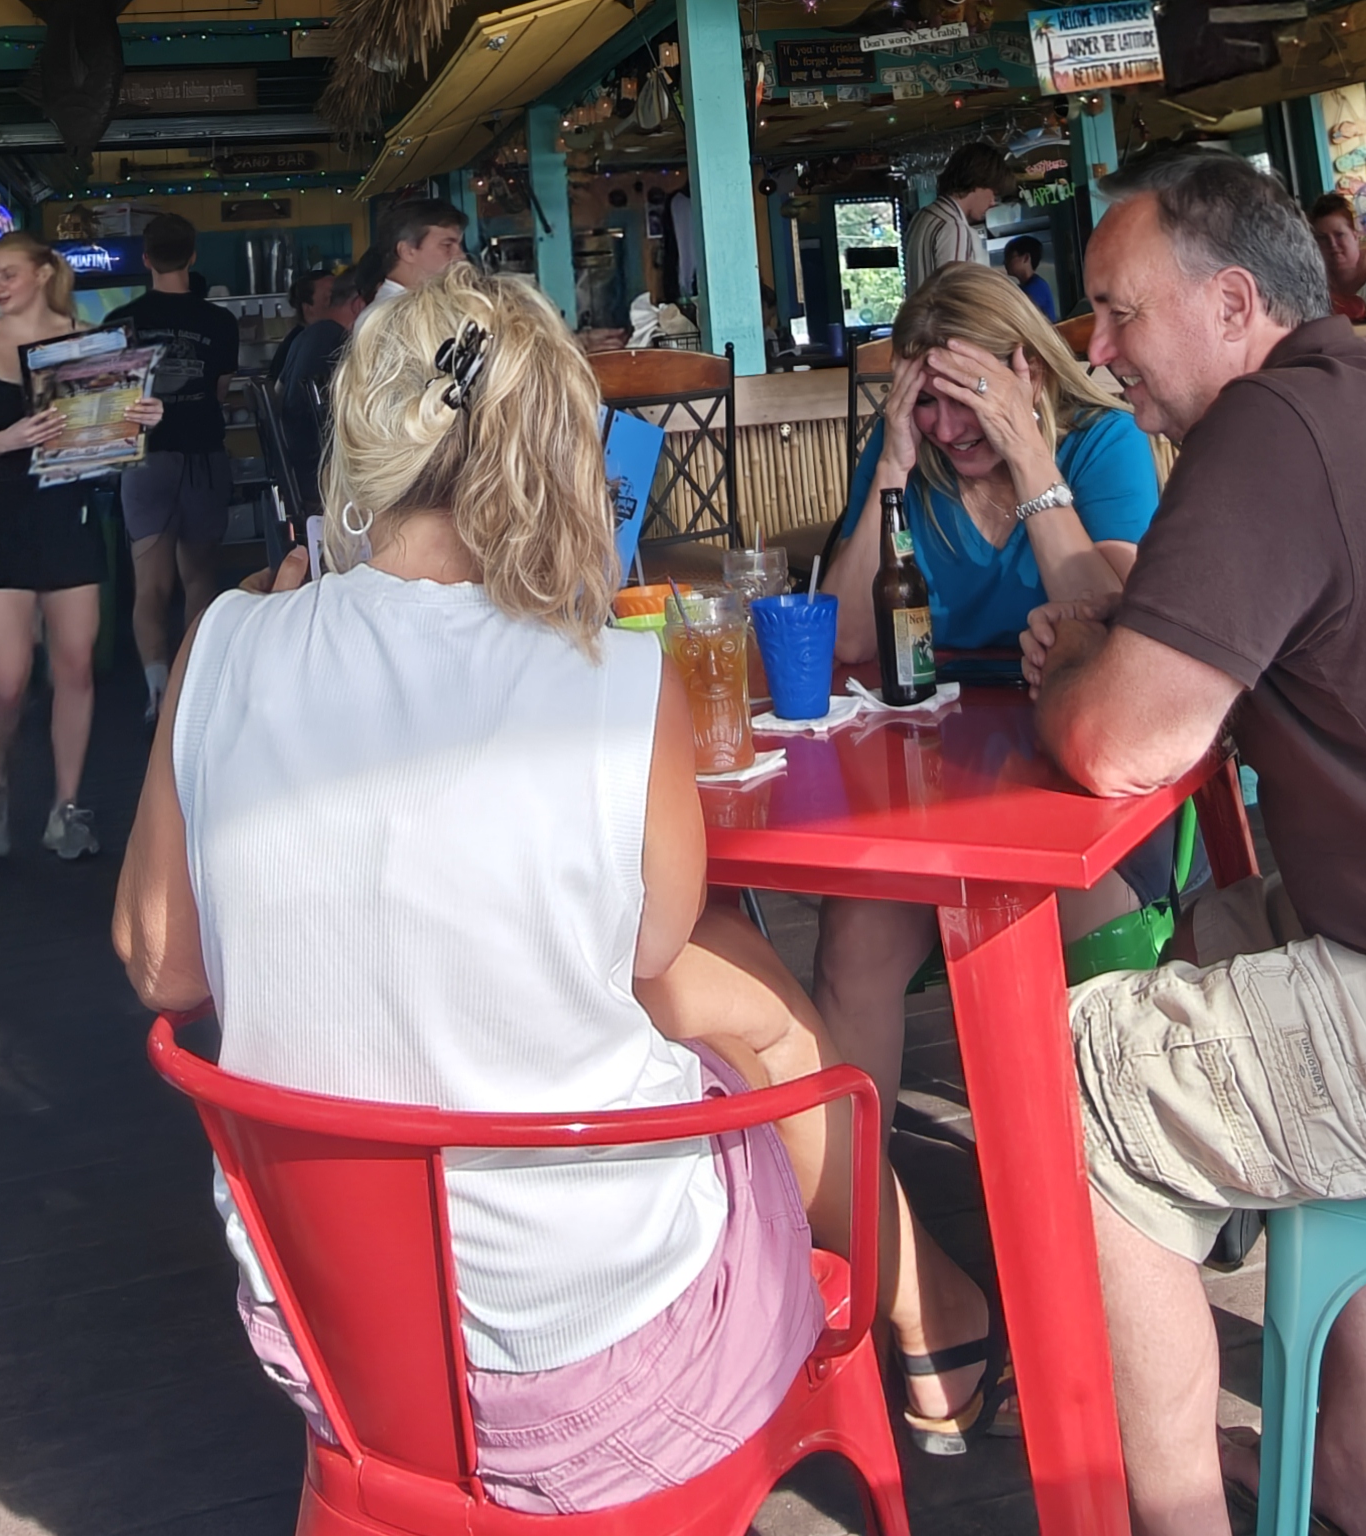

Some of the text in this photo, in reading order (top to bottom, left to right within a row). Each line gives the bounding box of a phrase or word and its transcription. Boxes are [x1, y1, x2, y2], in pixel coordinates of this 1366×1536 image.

[1057, 2, 1149, 31] WELCOME TO PARADISE
[863, 26, 962, 49] Don't worry, be Crabby
[1066, 30, 1155, 58] WARMER THE LATITUDE
[788, 54, 865, 68] to forget, please
[795, 45, 826, 57] you're
[1073, 57, 1160, 87] BETTER THE ATTITUDE
[155, 80, 174, 100] with
[182, 79, 210, 103] fishing
[233, 151, 307, 170] SAND BAR
[65, 250, 114, 272] QUAFINA
[1301, 1037, 1327, 1099] UNIONBAY
